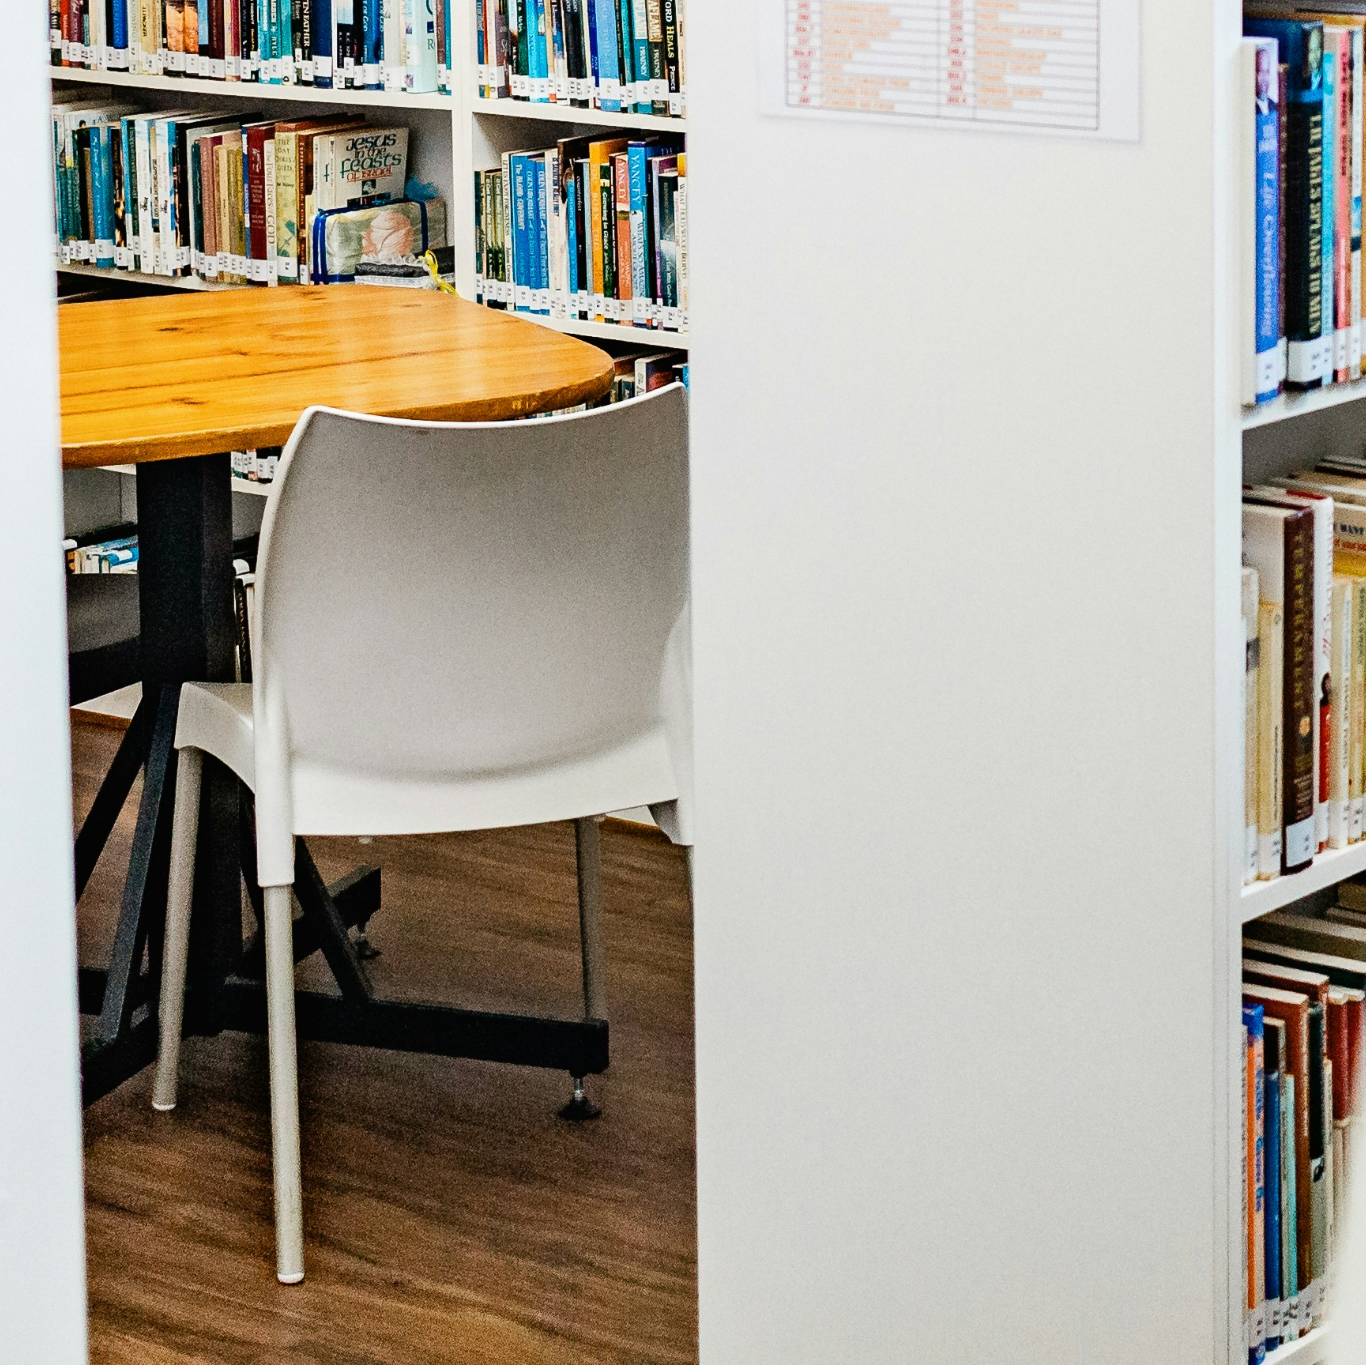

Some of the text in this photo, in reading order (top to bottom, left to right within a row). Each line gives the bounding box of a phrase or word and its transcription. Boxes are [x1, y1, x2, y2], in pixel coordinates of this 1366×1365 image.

[666, 26, 675, 58] HEALS
[618, 161, 626, 200] YANCEY
[631, 154, 641, 204] YANCEY
